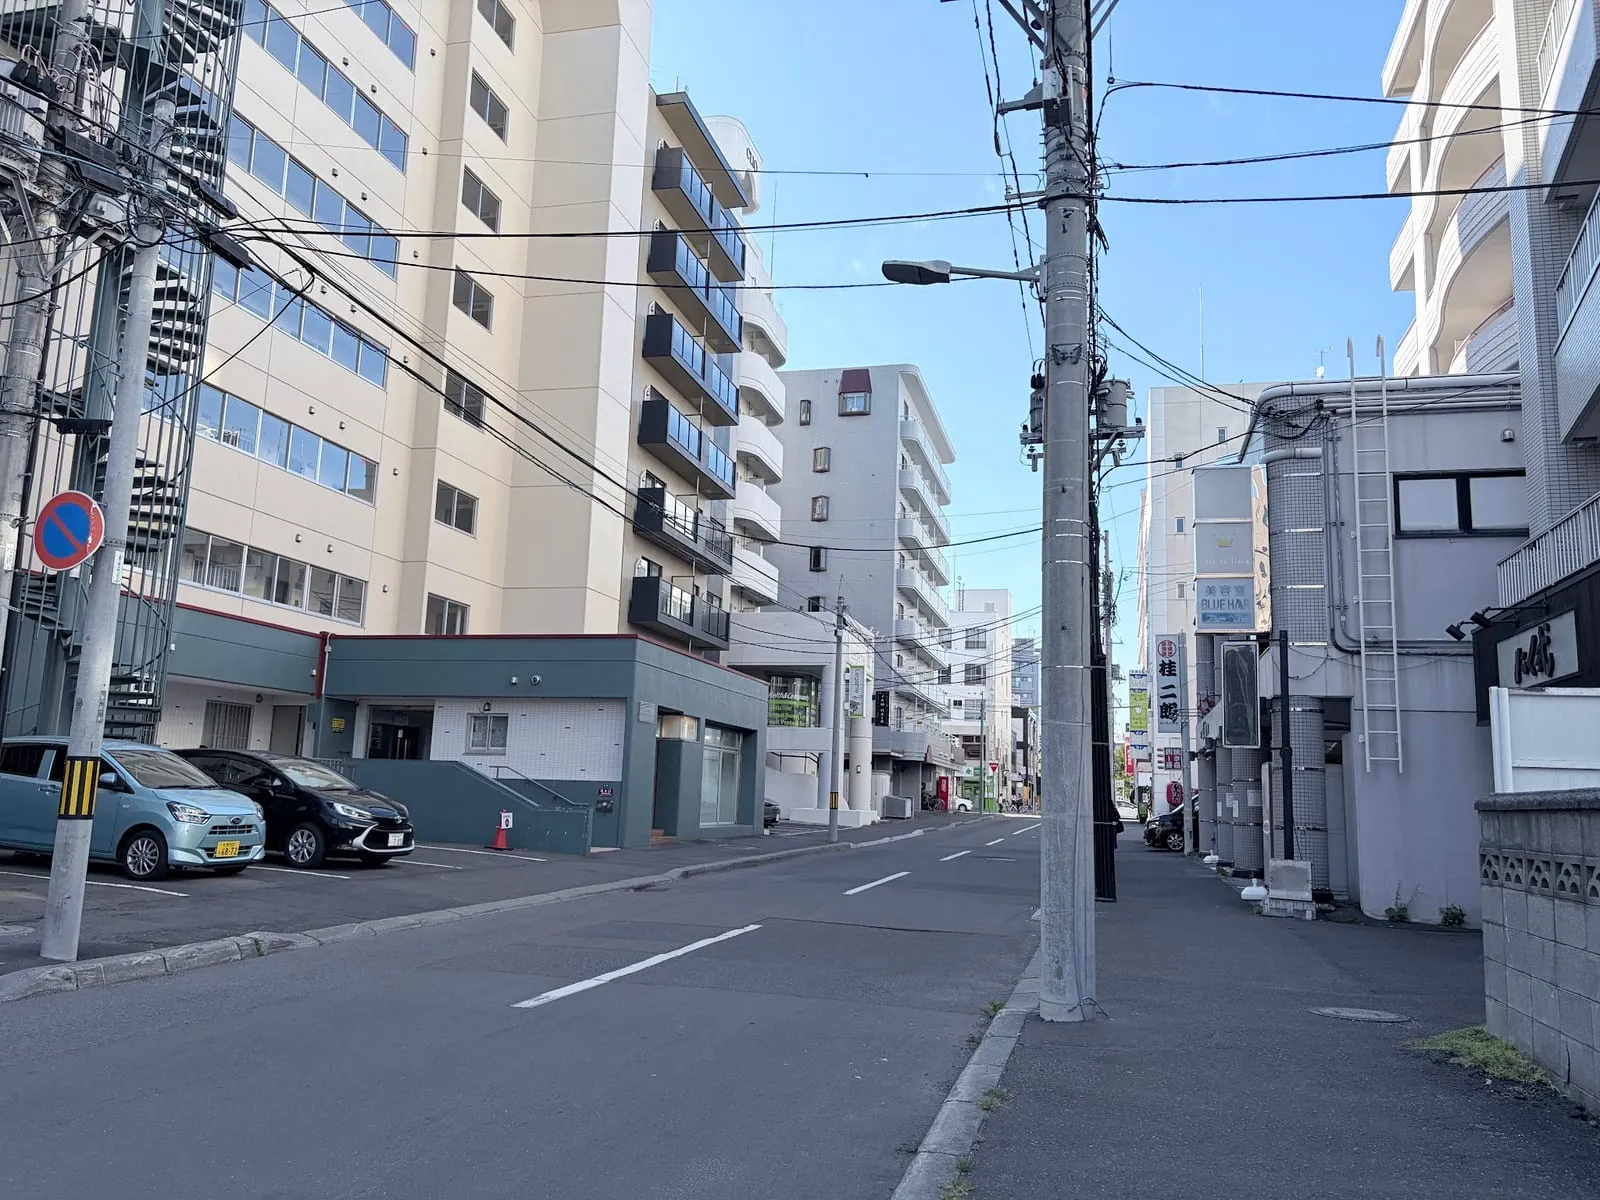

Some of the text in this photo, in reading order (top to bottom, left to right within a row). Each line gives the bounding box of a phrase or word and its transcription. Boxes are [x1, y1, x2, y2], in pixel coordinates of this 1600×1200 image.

[1205, 585, 1246, 597] 美容室
[1201, 599, 1226, 610] BLUE
[1159, 659, 1180, 723] 桂二郎
